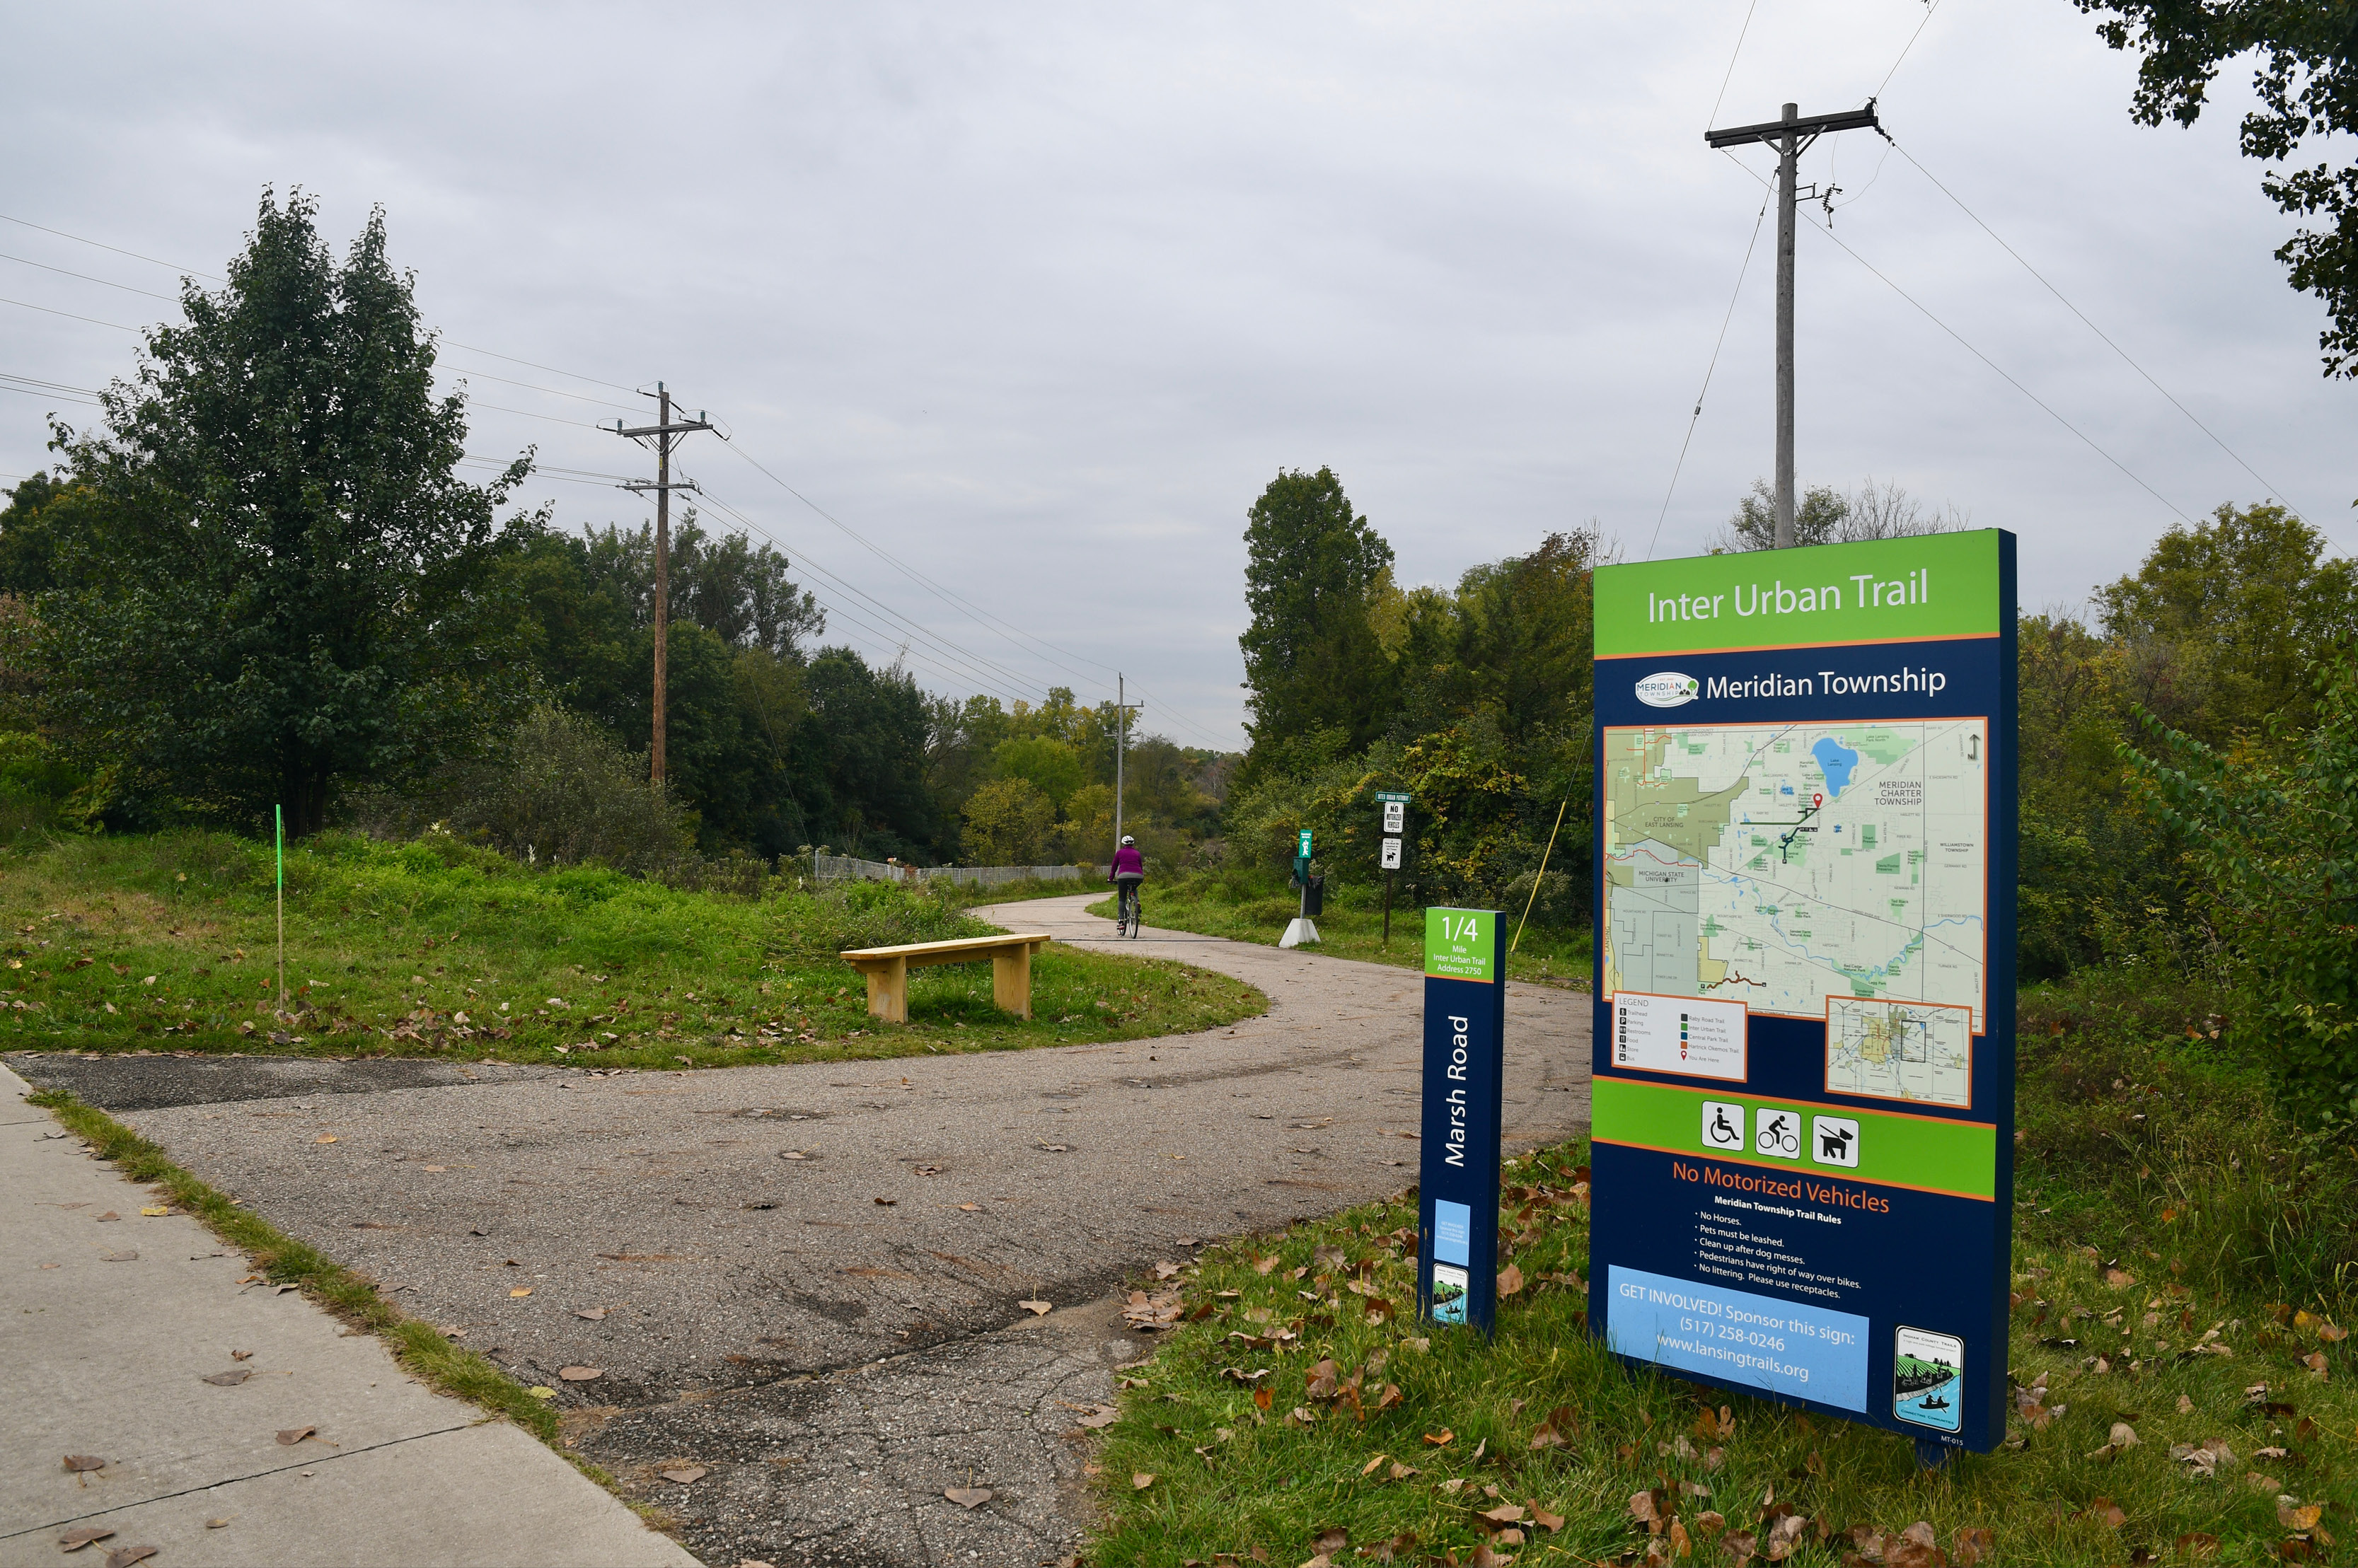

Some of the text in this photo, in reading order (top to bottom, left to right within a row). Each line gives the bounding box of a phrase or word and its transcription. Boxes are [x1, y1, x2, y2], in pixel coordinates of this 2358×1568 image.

[1648, 568, 1927, 622] Inter Urban Trail
[1637, 683, 1681, 691] MERIDIAN
[1707, 667, 1946, 699] Meridian Township
[1443, 917, 1478, 941] 1/4
[1450, 955, 1470, 963] Urban
[1472, 957, 1486, 965] Trail
[1452, 945, 1467, 953] Mile
[1438, 964, 1463, 973] Address
[1619, 998, 1648, 1006] LEGEND
[1445, 1015, 1469, 1168] Marsh Road
[1674, 1161, 1890, 1213] No Motorized Vehicles
[1700, 1211, 1741, 1226] No Horses.
[1715, 1196, 1842, 1224] Meridian Township Trail Rules
[1700, 1225, 1784, 1247] Pets must be leashed.
[1700, 1238, 1721, 1248] Clean
[1735, 1245, 1754, 1255] after
[1756, 1248, 1772, 1260] dog
[1774, 1253, 1805, 1265] messes.
[1699, 1250, 1744, 1266] Pedestrians
[1746, 1259, 1764, 1270] have
[1767, 1265, 1786, 1274] right
[1798, 1271, 1815, 1281] way
[1817, 1274, 1835, 1283] over
[1837, 1277, 1861, 1289] bikes.
[1699, 1263, 1840, 1299] No littering. Please use receptacles.
[1620, 1283, 1855, 1345] GET INVOLVED! Sponsor this sign:
[1680, 1317, 1784, 1351] (517) 258-0246
[1657, 1334, 1808, 1382] www.lansingtrails.org
[1941, 1435, 1963, 1446] MT-015
